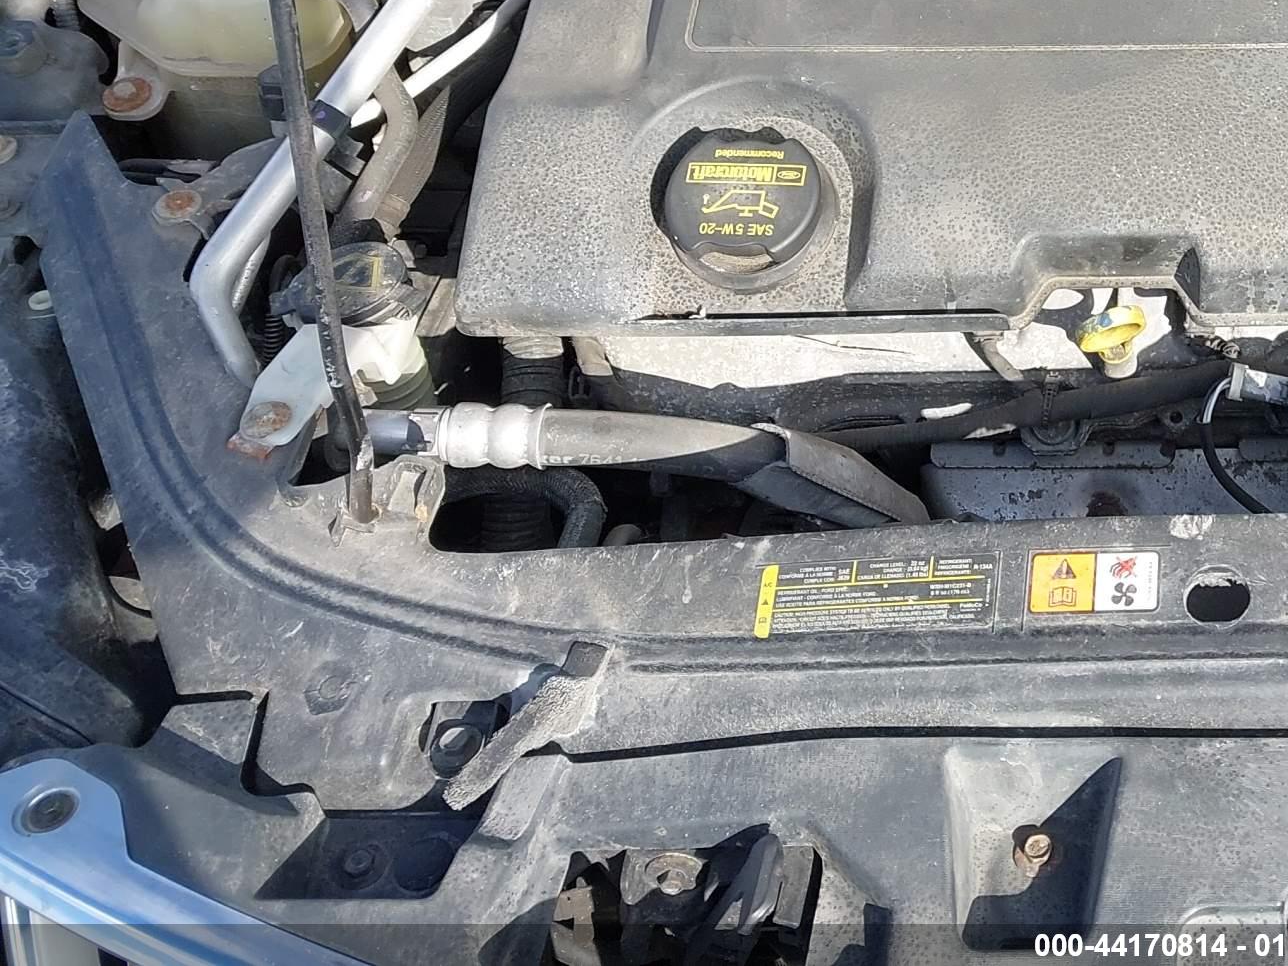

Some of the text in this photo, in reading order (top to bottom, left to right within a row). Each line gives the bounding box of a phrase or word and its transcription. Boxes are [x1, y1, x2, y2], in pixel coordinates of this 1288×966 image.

[715, 149, 785, 160] Recommended
[692, 165, 774, 182] Motorcraft
[699, 223, 774, 236] SAE 5W-20
